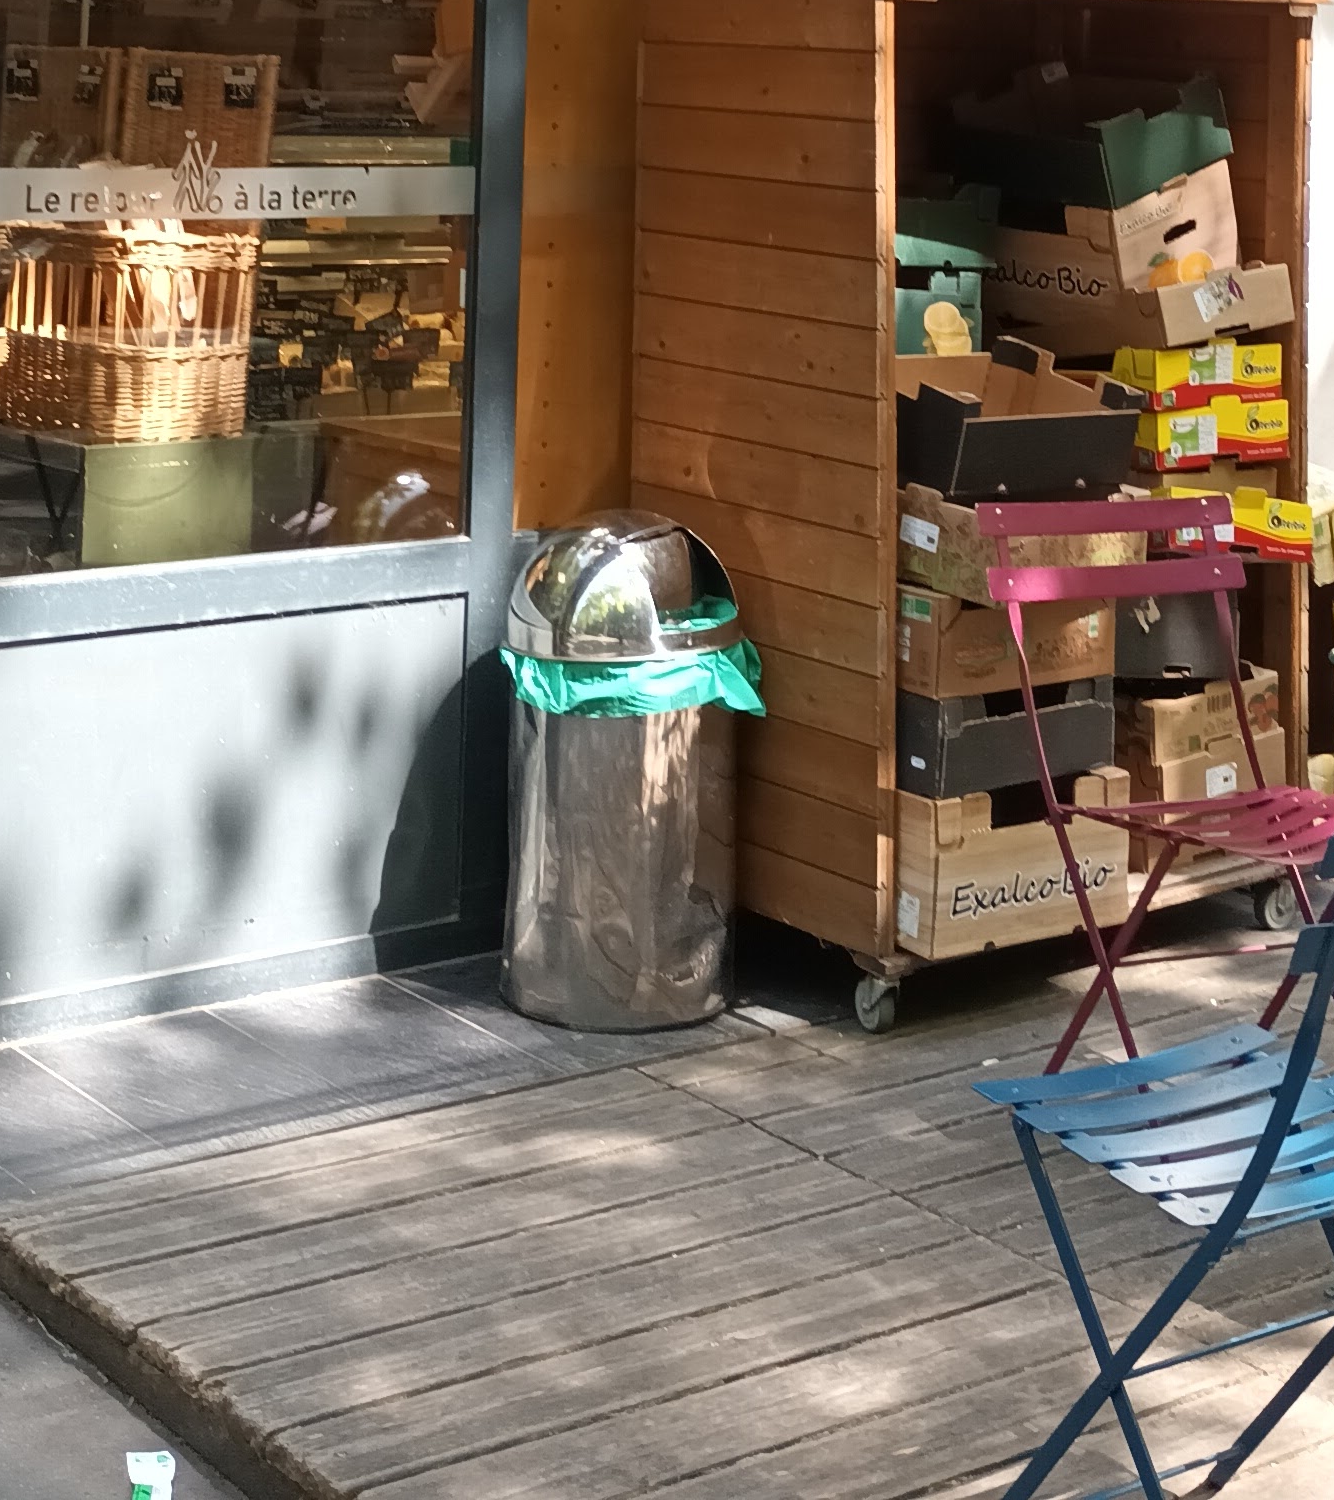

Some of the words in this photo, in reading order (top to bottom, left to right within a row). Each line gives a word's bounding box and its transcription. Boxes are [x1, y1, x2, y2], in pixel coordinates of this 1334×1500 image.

[25, 183, 61, 214] Le
[234, 182, 250, 211] à
[258, 183, 282, 211] la
[291, 183, 358, 212] terre
